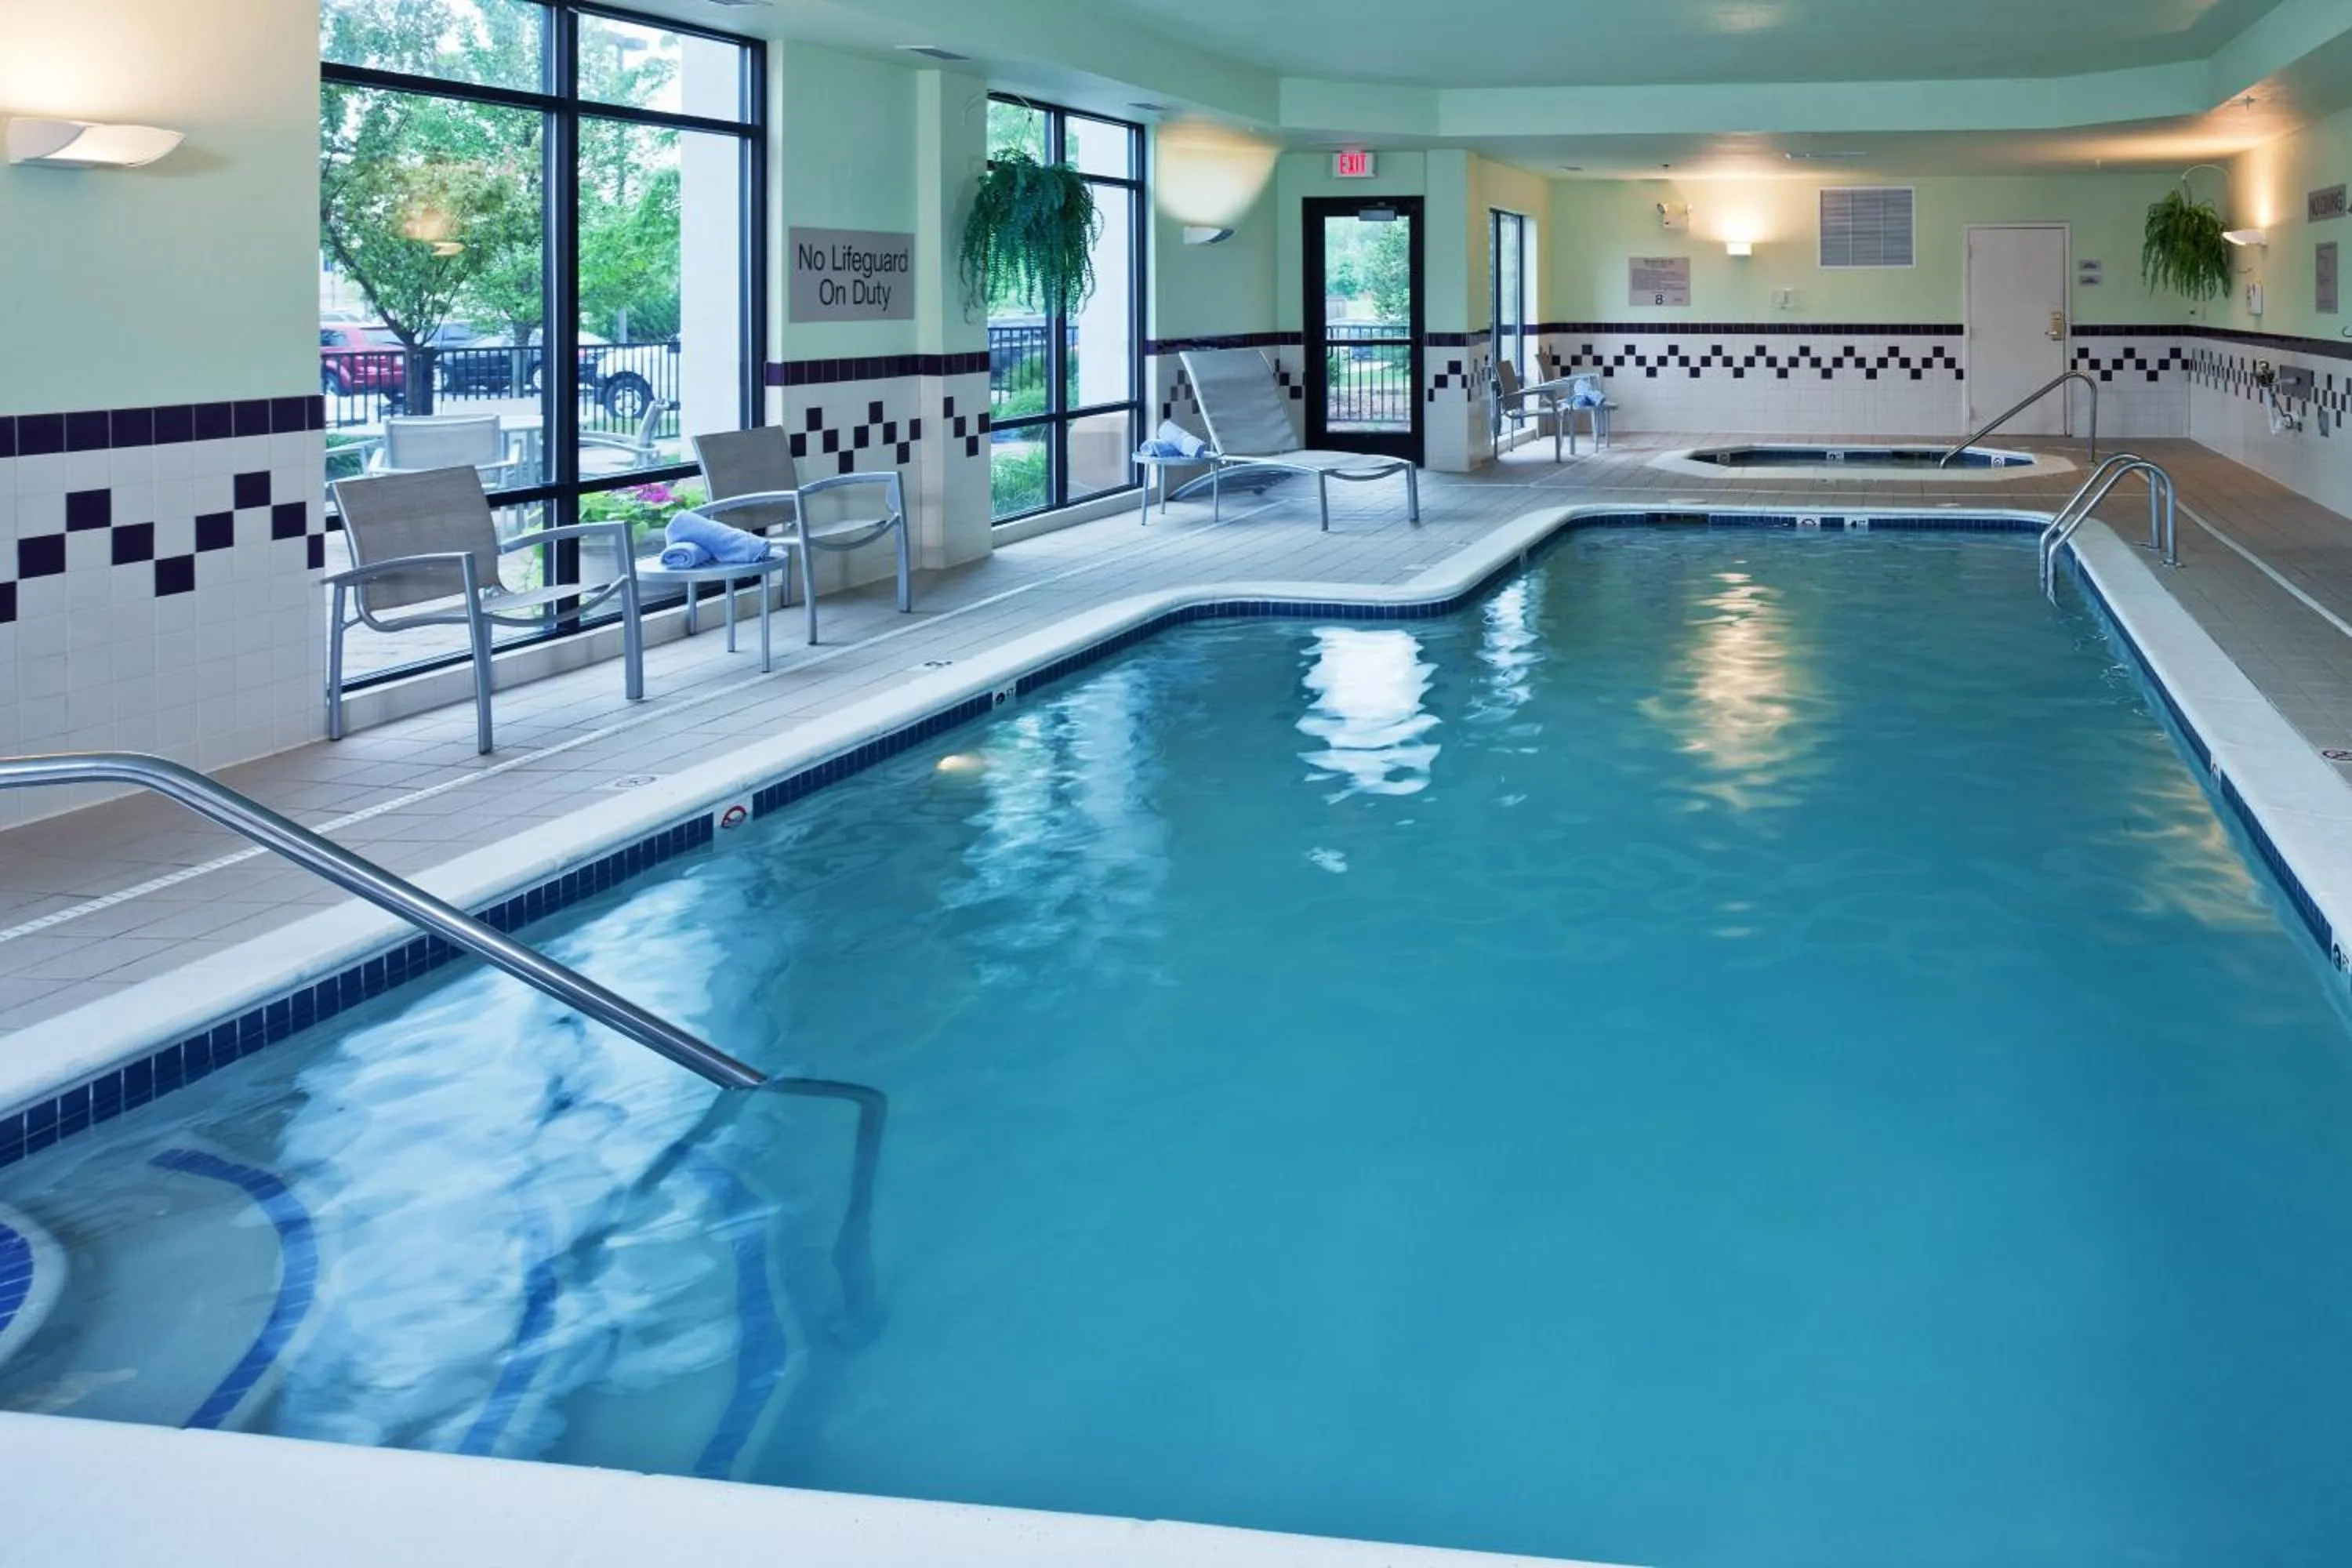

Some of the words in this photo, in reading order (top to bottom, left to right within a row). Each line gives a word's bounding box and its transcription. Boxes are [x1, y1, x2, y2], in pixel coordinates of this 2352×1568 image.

[1339, 152, 1367, 175] EXIT
[798, 244, 826, 271] No
[832, 244, 909, 278] Lifeguard
[819, 278, 846, 306] On
[852, 279, 892, 311] Duty
[1655, 294, 1664, 306] 8
